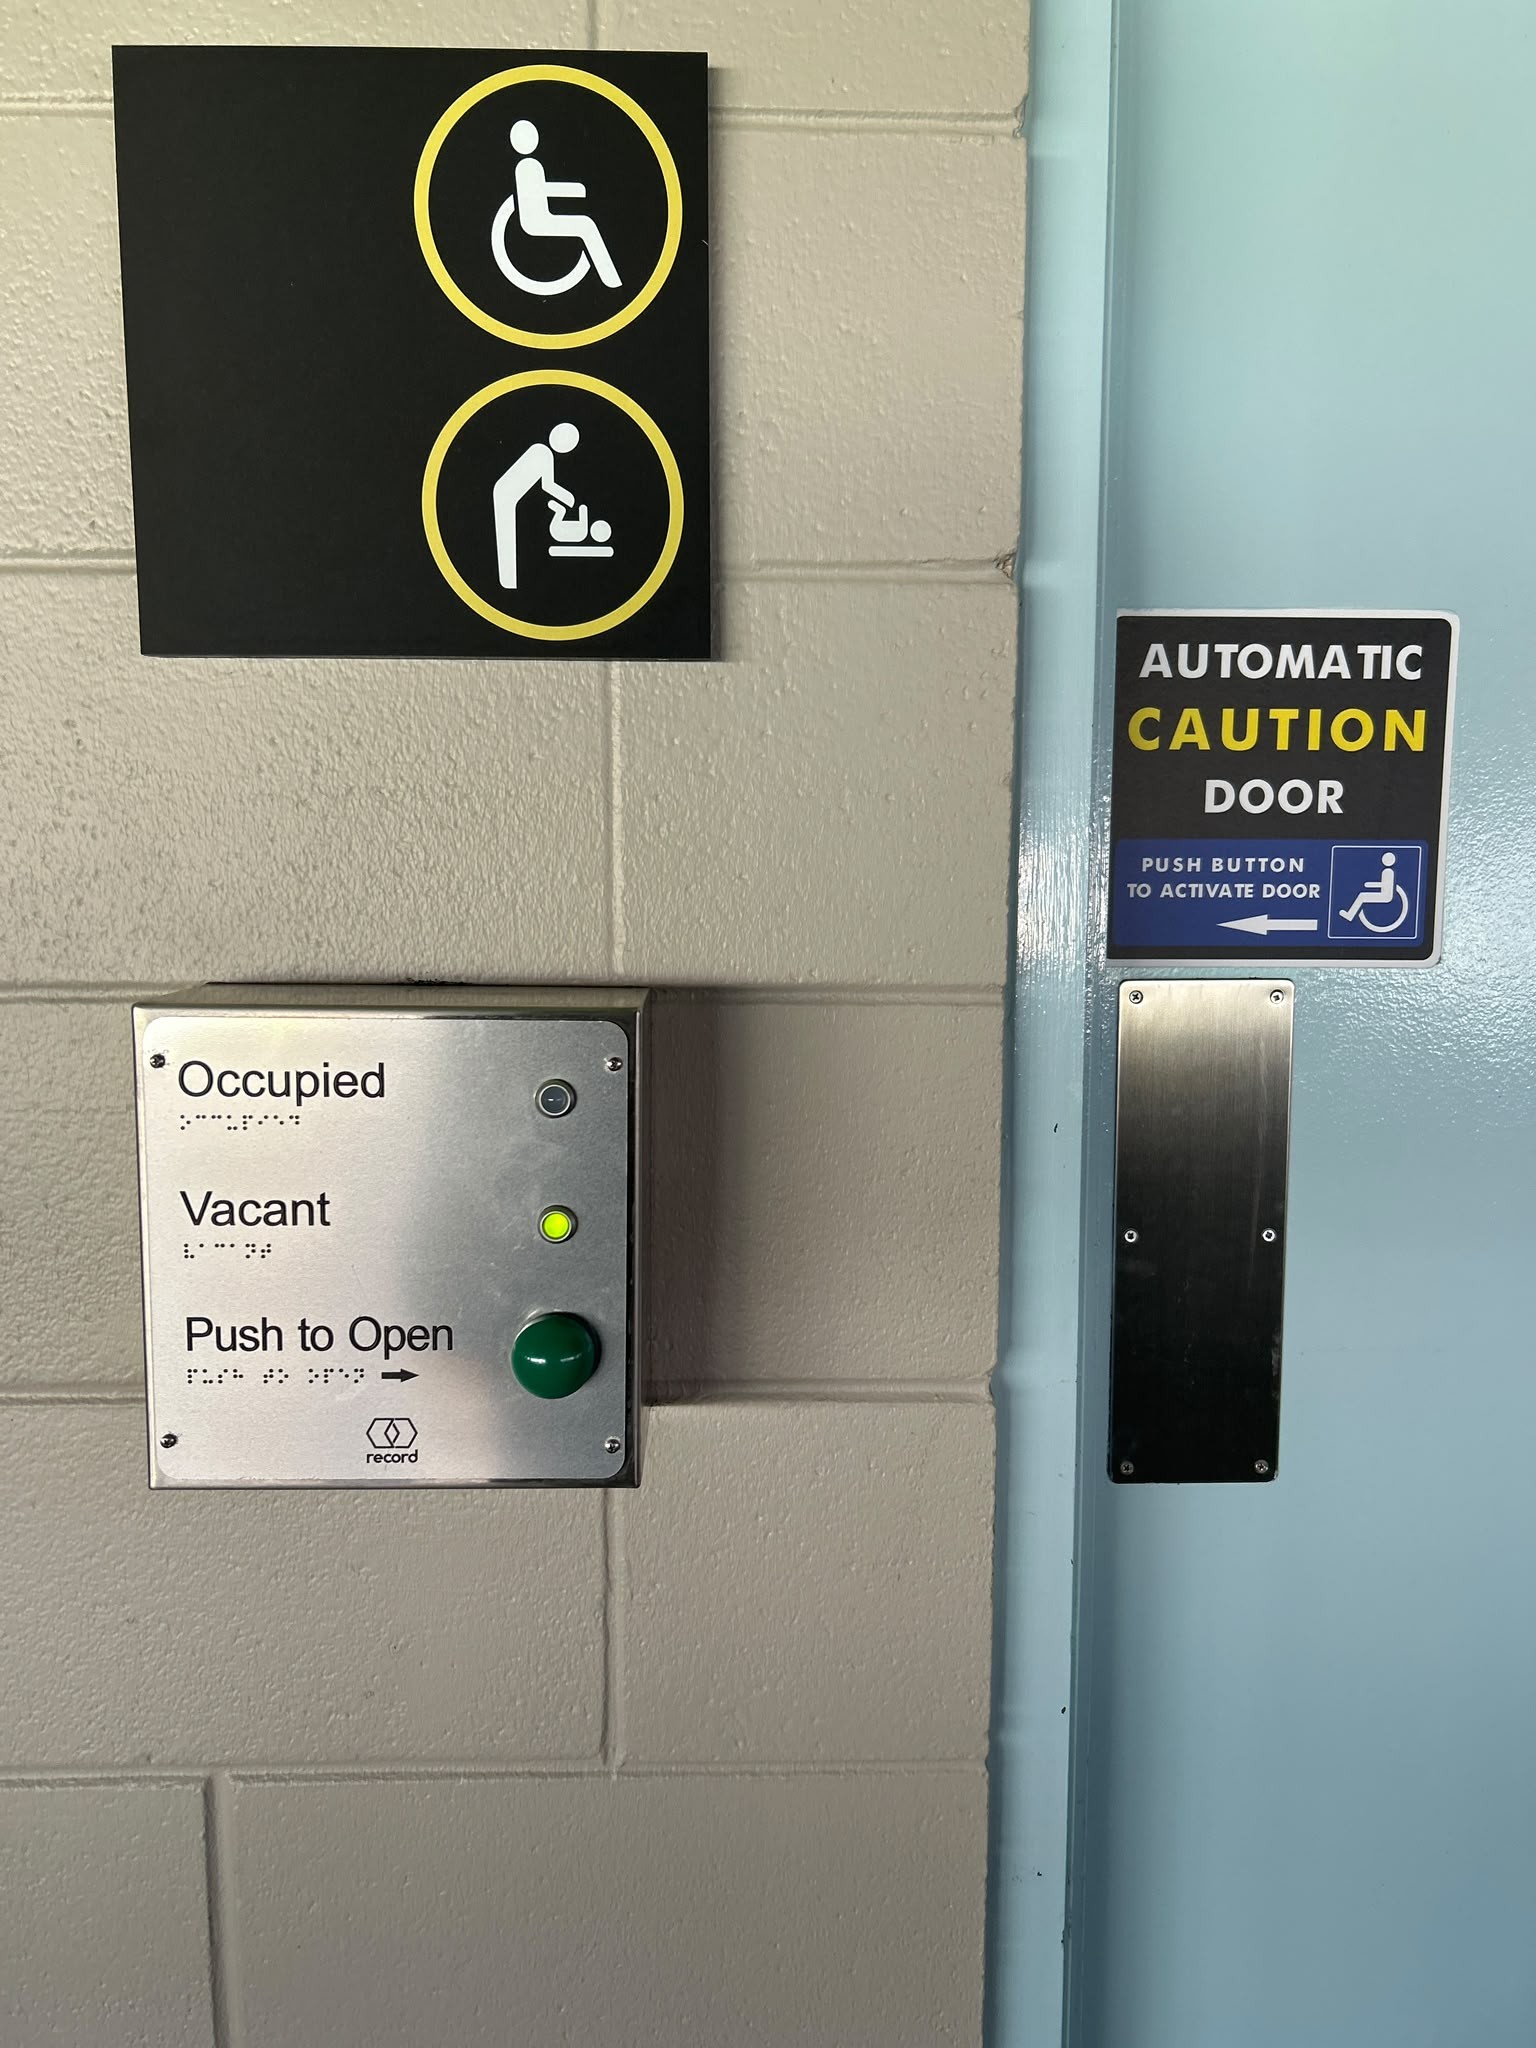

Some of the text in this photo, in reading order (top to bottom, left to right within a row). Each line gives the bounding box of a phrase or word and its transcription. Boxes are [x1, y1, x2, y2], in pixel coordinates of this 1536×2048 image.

[1139, 643, 1423, 681] AUTOMATIC
[1128, 707, 1426, 752] CAUTION
[1204, 779, 1344, 814] DOOR
[1141, 857, 1305, 873] PUSH BUTTON
[1127, 883, 1321, 899] TO ACTIVATE DOOR
[178, 1060, 385, 1107] Occupied
[180, 1190, 331, 1227] Vacant
[185, 1316, 453, 1360] Push to Open
[366, 1449, 418, 1464] record
